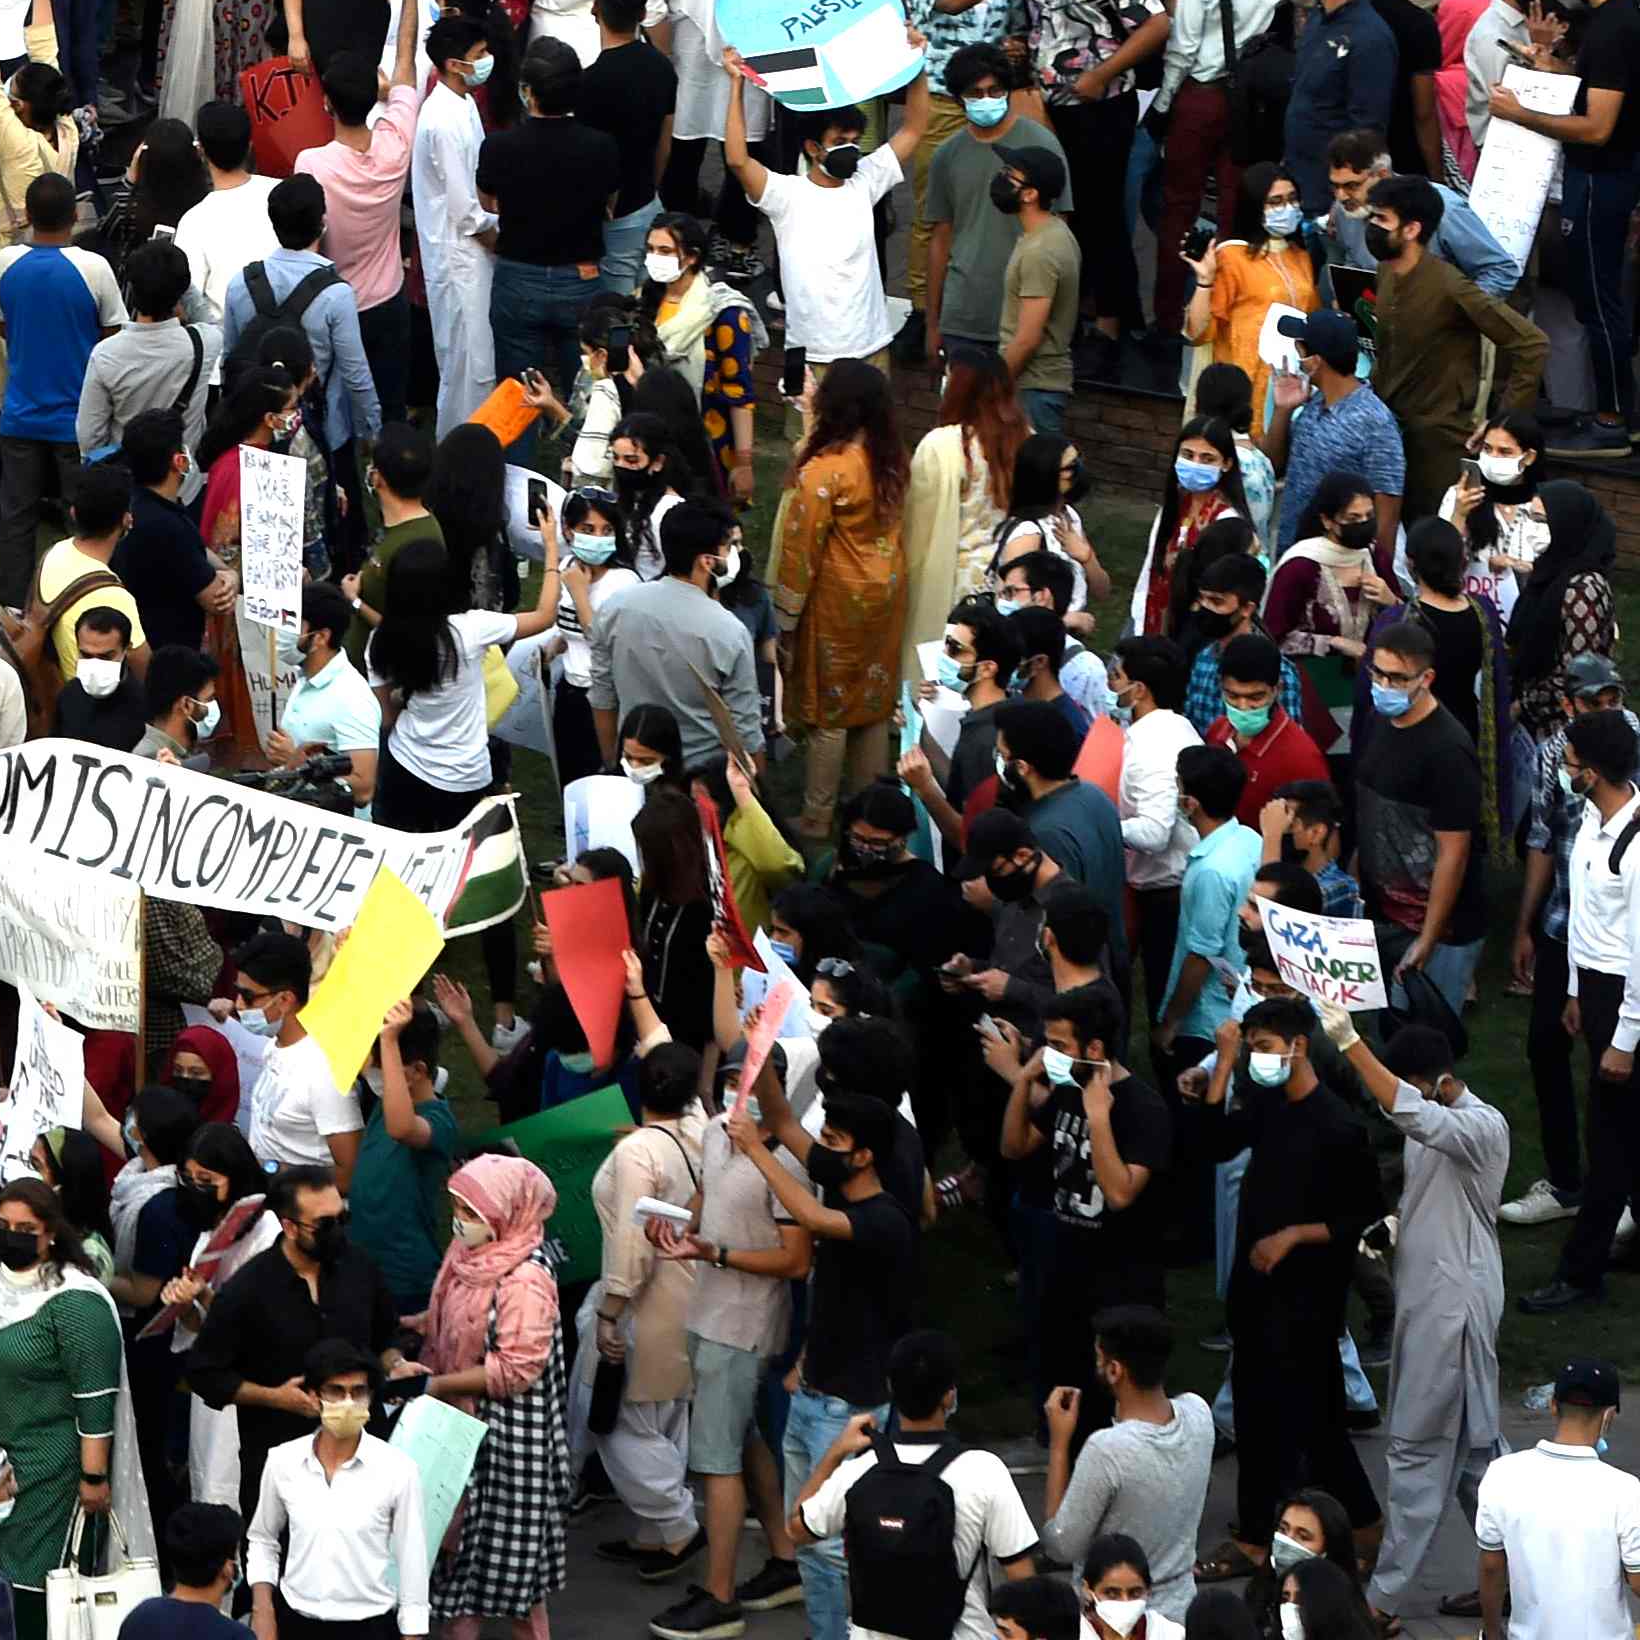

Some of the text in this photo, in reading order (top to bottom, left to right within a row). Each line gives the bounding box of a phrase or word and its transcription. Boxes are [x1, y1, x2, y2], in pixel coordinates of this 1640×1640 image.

[44, 755, 133, 868] IS
[120, 777, 373, 924] INCOMPLETE
[1268, 909, 1328, 955] GAZA
[1277, 953, 1365, 1004] ATTACK
[1305, 953, 1378, 983] UNDER
